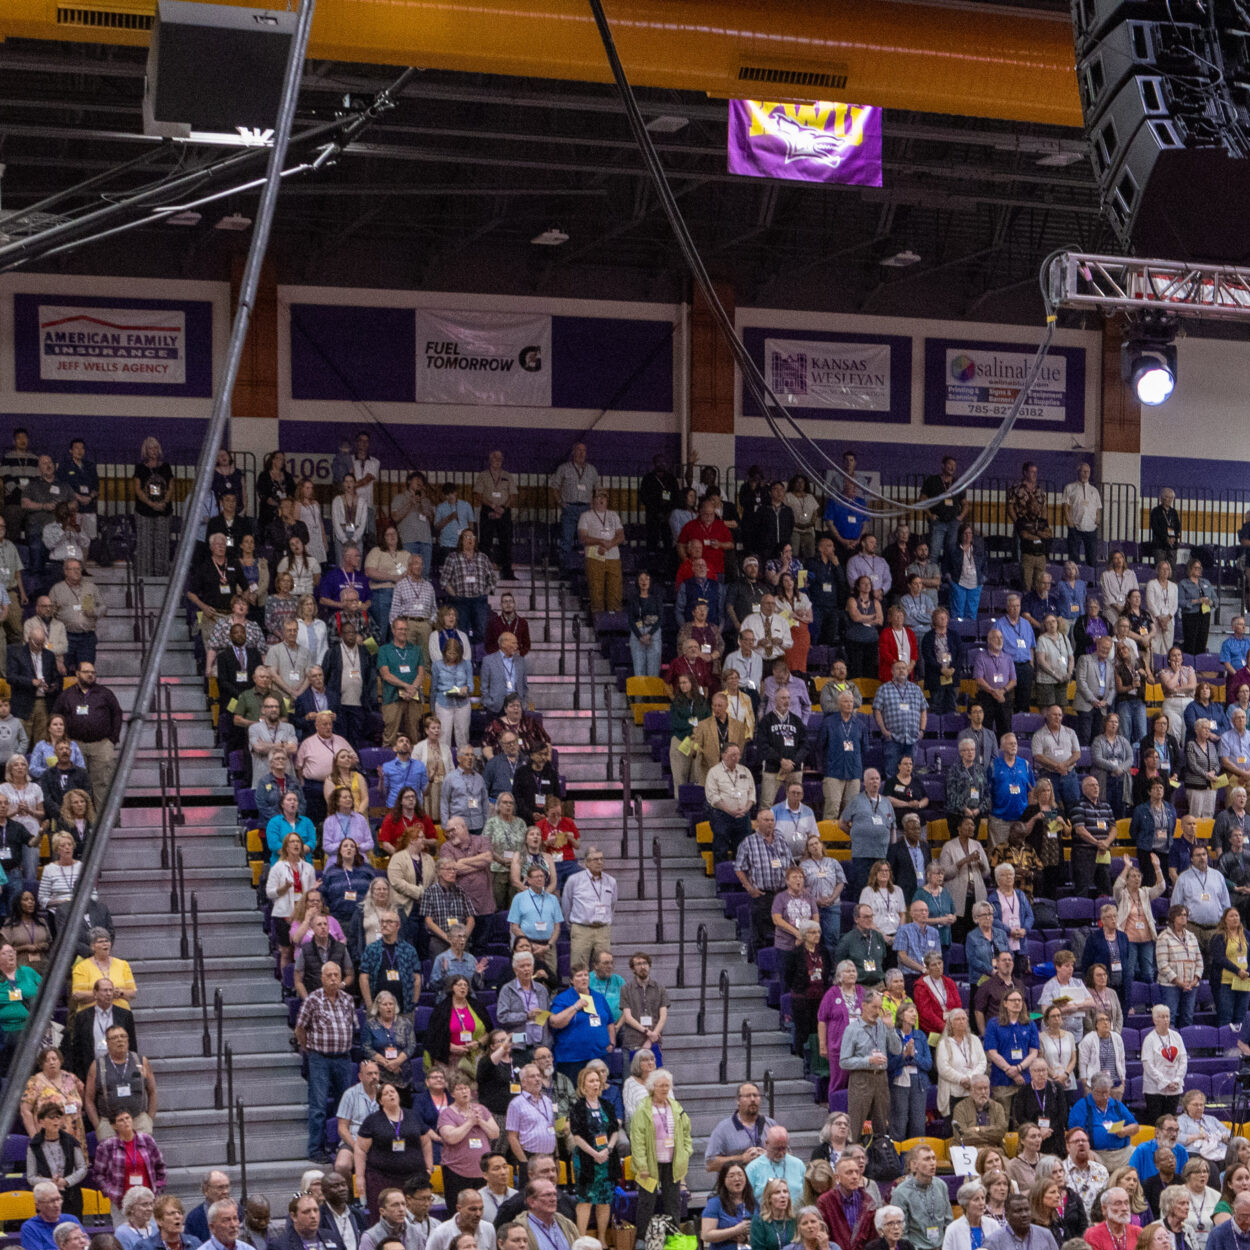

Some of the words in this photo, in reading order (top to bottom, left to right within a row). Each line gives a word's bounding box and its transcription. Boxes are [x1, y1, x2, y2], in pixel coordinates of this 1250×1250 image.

[44, 332, 121, 345] AMERICAN
[127, 334, 178, 347] FAMILY
[54, 346, 168, 357] INSURANCE
[425, 341, 461, 355] FUEL
[426, 356, 514, 372] TOMORROW
[518, 345, 541, 372] G
[812, 358, 867, 371] KANSAS
[57, 361, 79, 371] JEFF
[84, 362, 118, 372] WELLS
[122, 363, 169, 373] AGENCY
[976, 357, 1061, 381] salinabue
[811, 372, 885, 386] WESLEYAN
[968, 405, 1044, 417] 785-826182
[287, 458, 330, 479] 106
[771, 724, 797, 733] COYOES
[963, 1153, 971, 1165] 5
